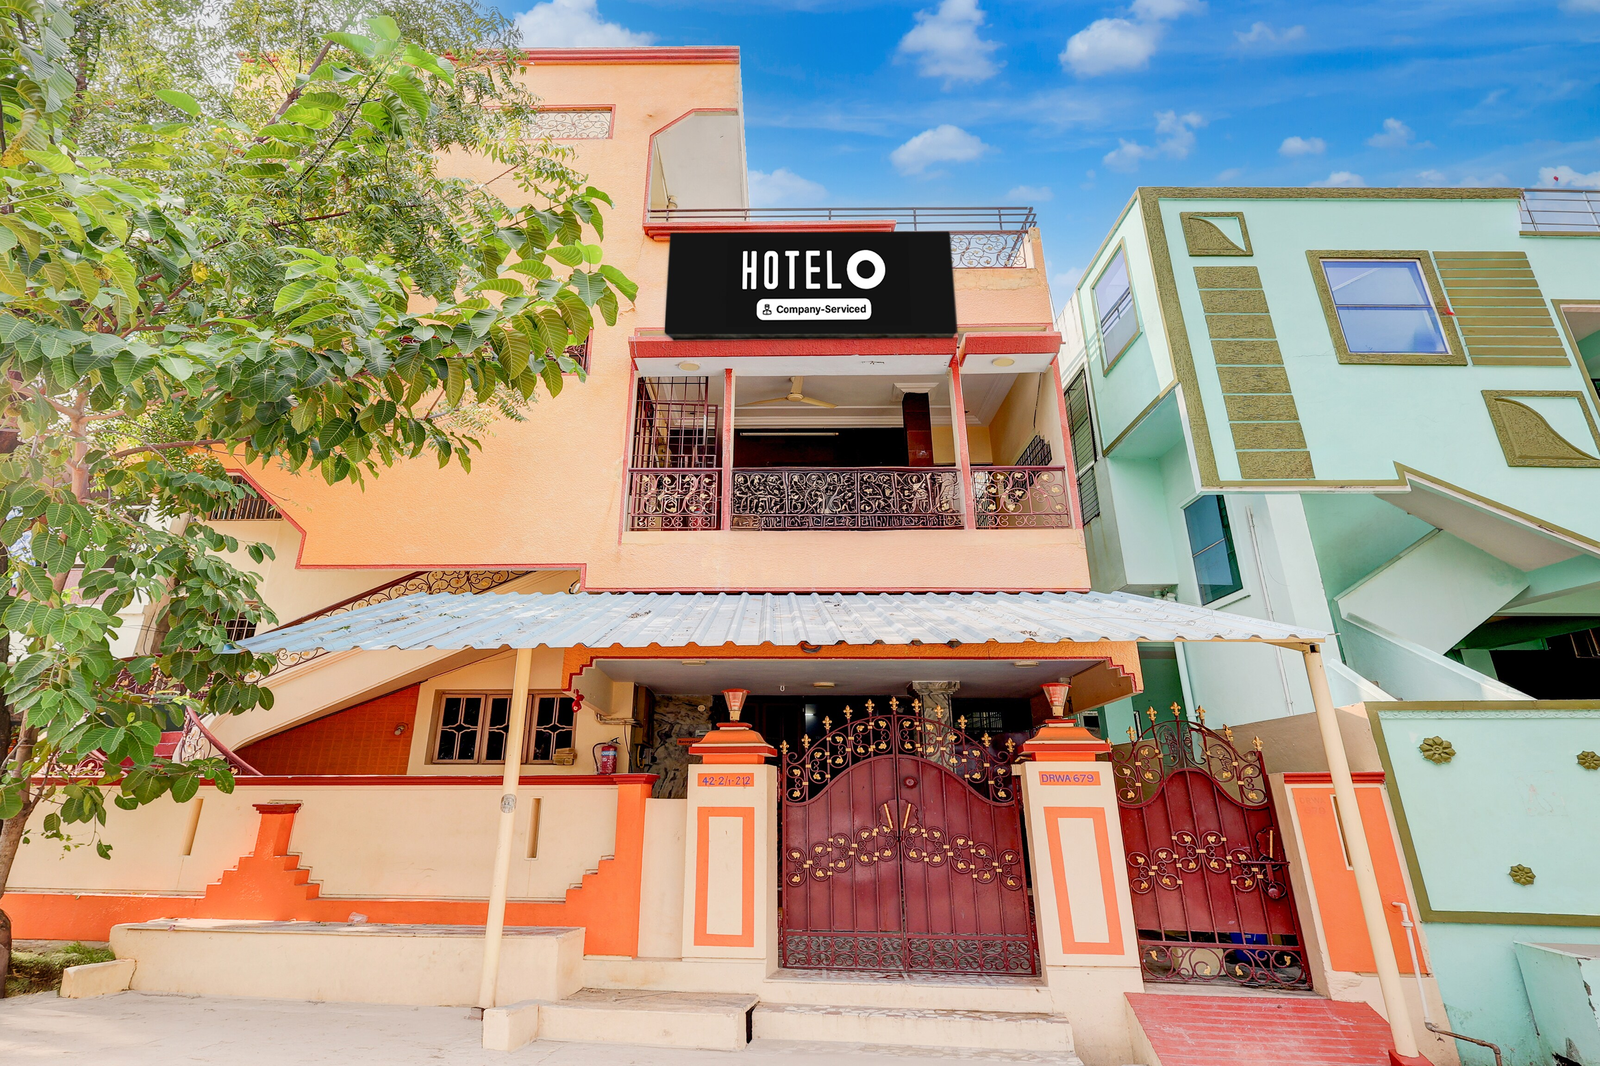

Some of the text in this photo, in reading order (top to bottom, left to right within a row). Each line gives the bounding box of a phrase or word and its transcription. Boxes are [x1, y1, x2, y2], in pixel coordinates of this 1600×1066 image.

[776, 304, 867, 316] Company-Serviced
[1041, 774, 1095, 783] DRWA 679
